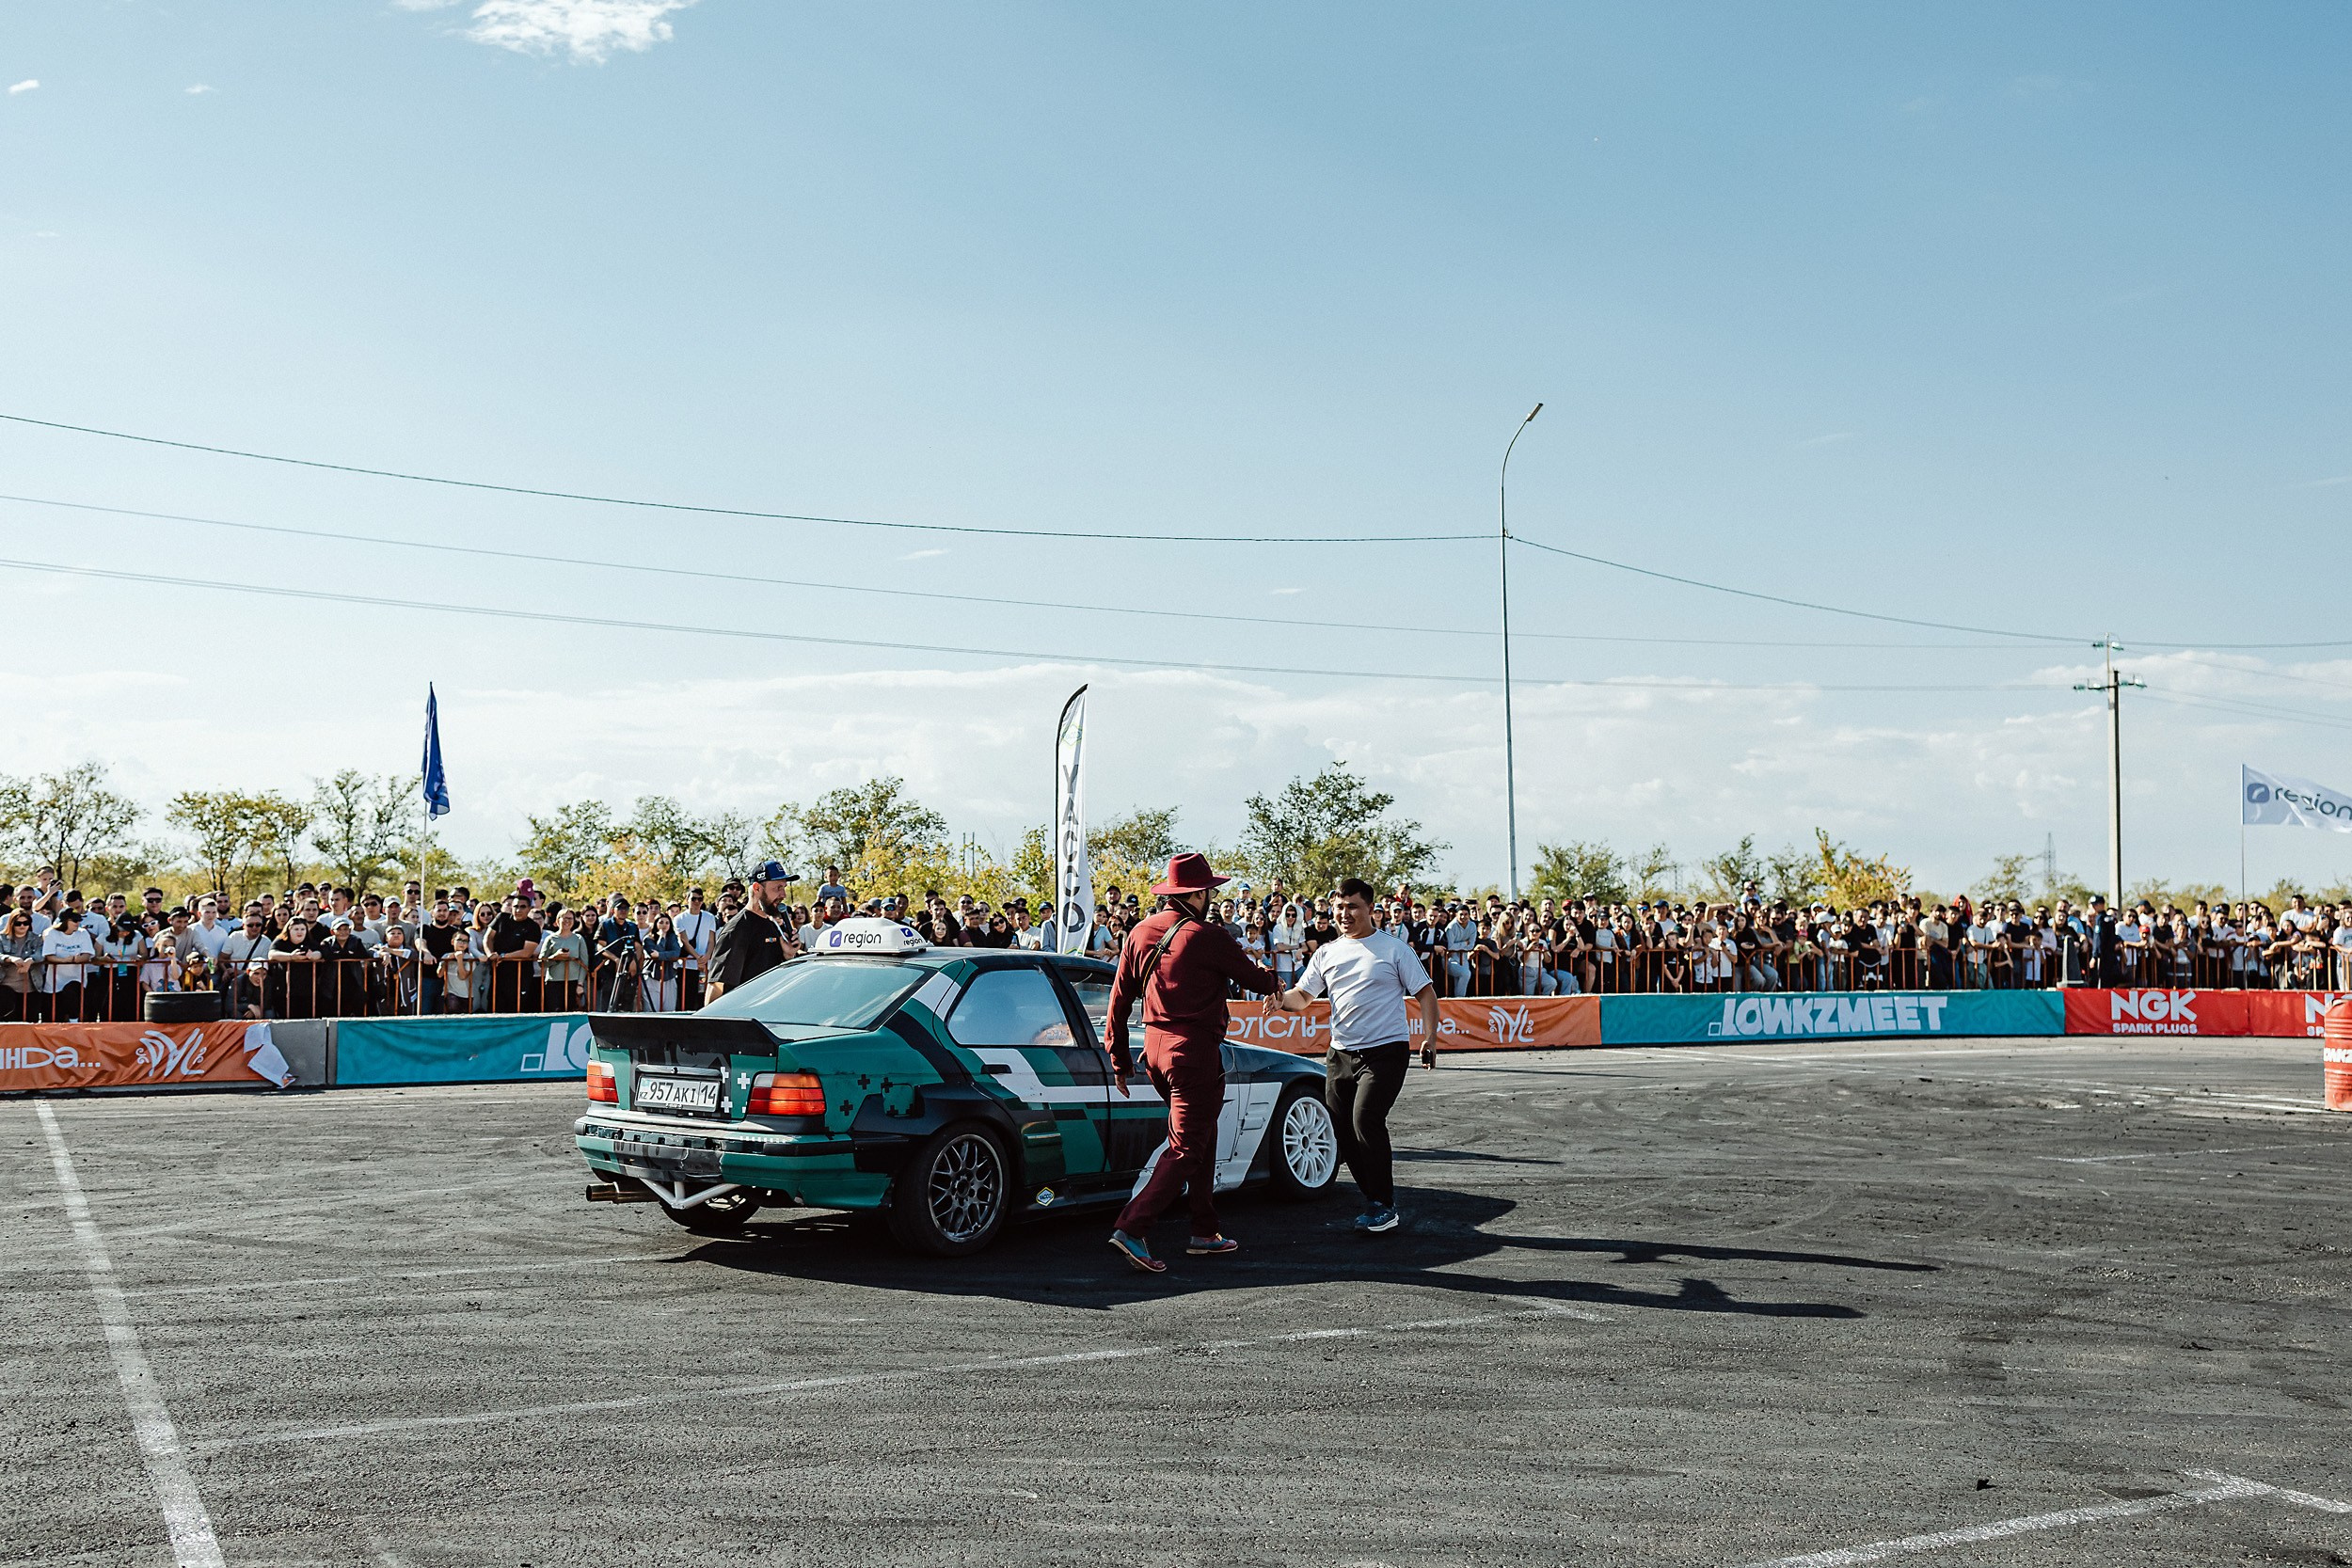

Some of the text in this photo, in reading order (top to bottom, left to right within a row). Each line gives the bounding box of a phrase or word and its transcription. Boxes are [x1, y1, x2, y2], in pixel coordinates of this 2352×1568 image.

[843, 930, 882, 948] region
[903, 937, 923, 947] region
[2110, 990, 2198, 1022] NGK
[2112, 1022, 2198, 1035] SPARK PLUGS
[701, 1085, 716, 1105] 14
